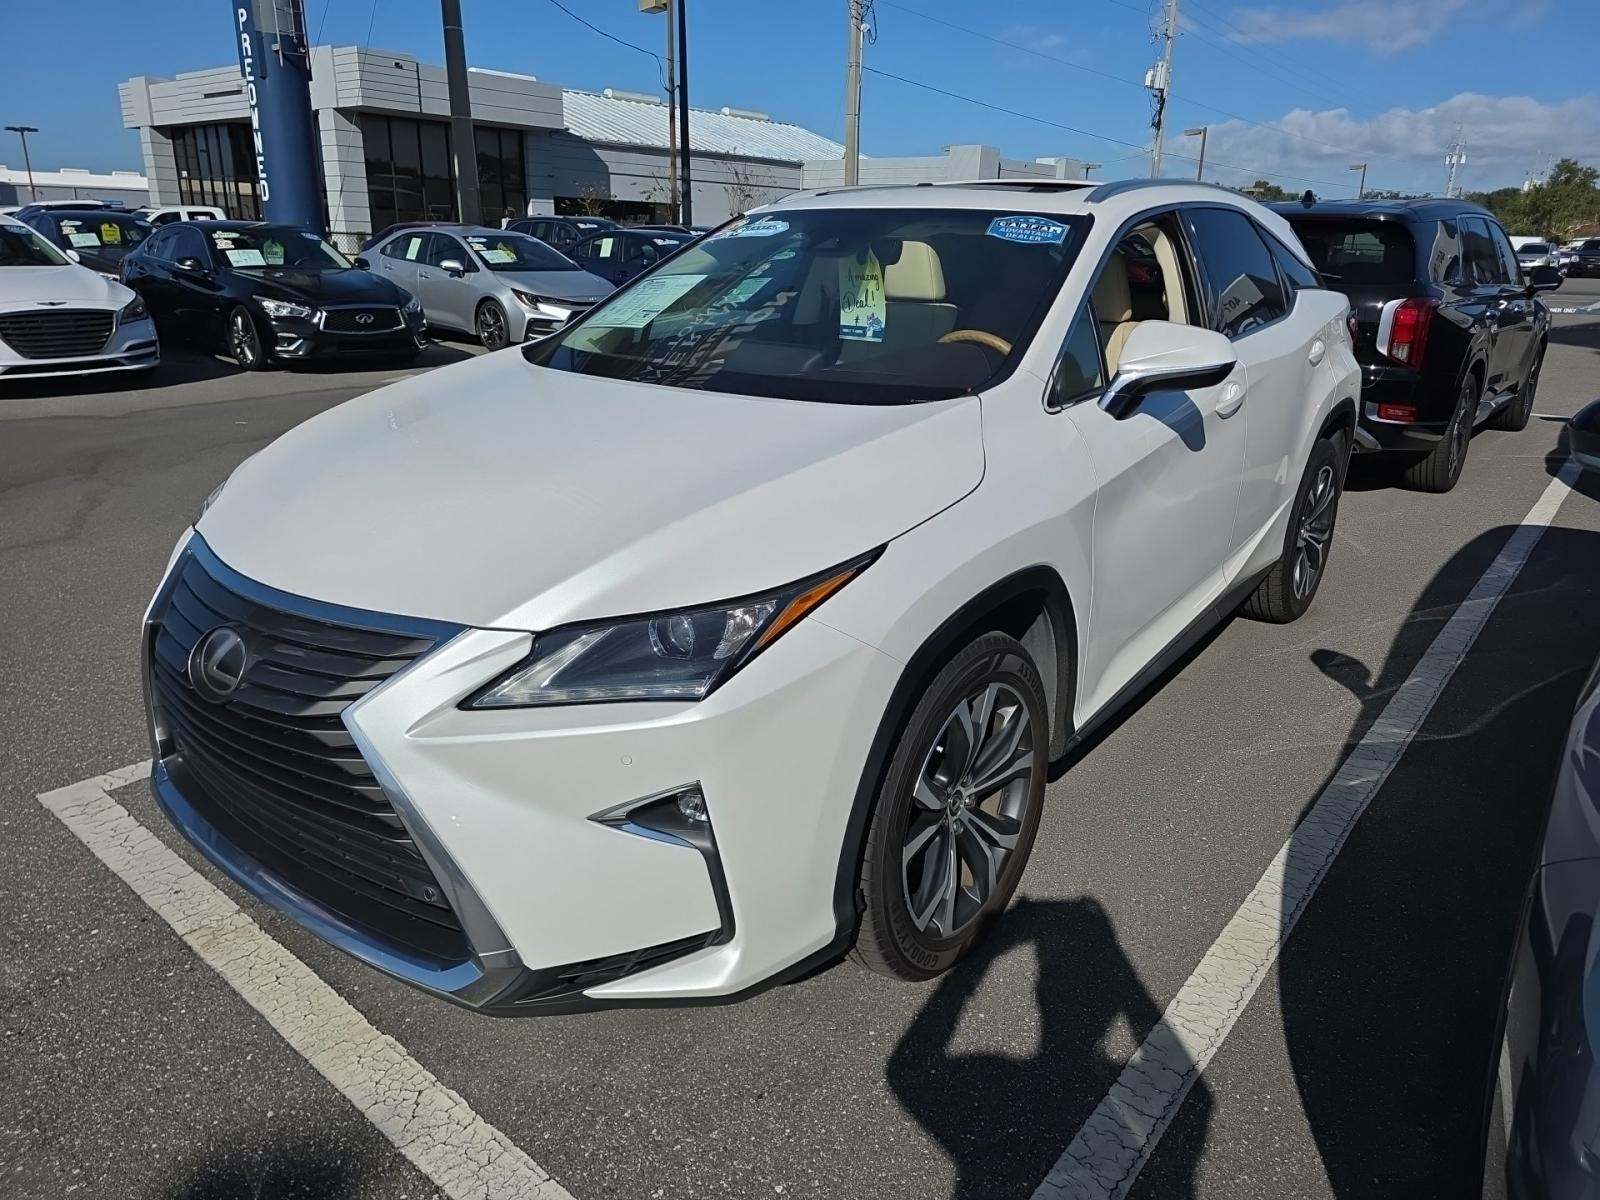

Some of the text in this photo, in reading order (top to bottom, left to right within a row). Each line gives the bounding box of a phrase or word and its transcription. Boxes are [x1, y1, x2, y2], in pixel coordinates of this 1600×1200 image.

[238, 8, 270, 202] PREOWNED
[1000, 227, 1054, 238] ADVANTAGE
[1005, 233, 1042, 241] DEALER
